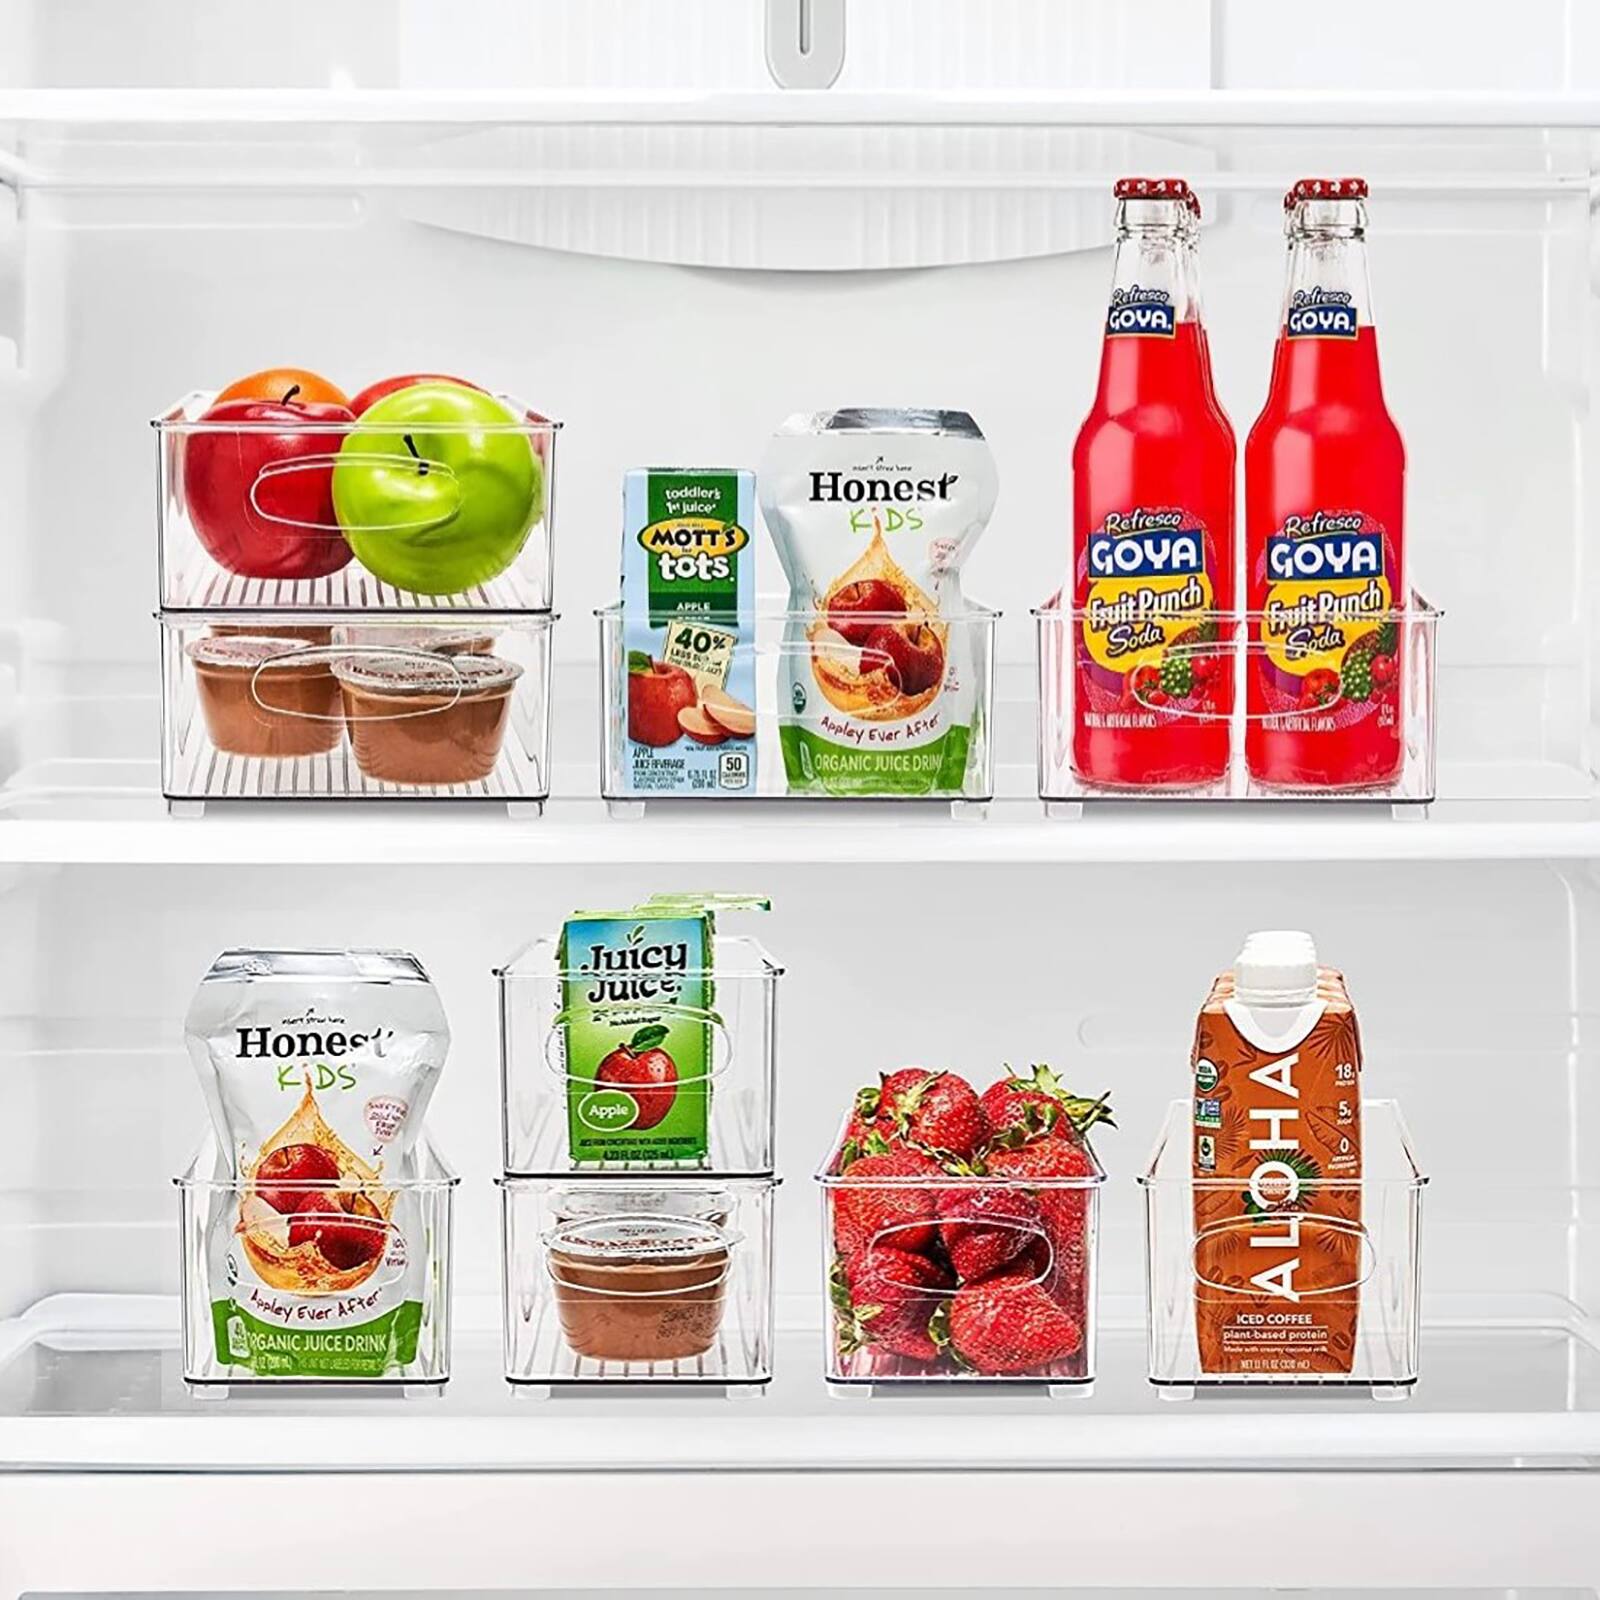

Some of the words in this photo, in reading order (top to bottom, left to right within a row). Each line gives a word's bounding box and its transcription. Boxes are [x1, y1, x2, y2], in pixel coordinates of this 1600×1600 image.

[1112, 285, 1169, 308] Refresco
[1294, 287, 1352, 310] Refresco
[808, 472, 959, 503] Honest
[1105, 508, 1182, 535] Refresco
[1285, 512, 1362, 538] Refresco
[1091, 537, 1197, 575] GOYA
[1270, 540, 1377, 578] GOYA
[676, 602, 711, 612] APPLE
[1091, 590, 1138, 630] Fruit
[1139, 577, 1202, 621] Punch
[1270, 594, 1317, 634] Fruit
[1319, 580, 1382, 622] Punch
[674, 627, 726, 654] 40%
[1108, 625, 1163, 656] Soda
[1288, 629, 1342, 658] Soda
[821, 715, 864, 744] Appley
[869, 729, 900, 742] Ever
[906, 712, 940, 738] After
[726, 757, 742, 771] 50
[814, 754, 872, 771] ORGANIC
[874, 754, 910, 771] JUICE
[912, 755, 943, 771] DRIN
[580, 942, 688, 977] Juicy
[235, 1027, 394, 1059] Honest
[589, 1103, 629, 1119] Apple
[1340, 1138, 1349, 1153] 0
[1249, 1052, 1300, 1303] ALOHA
[250, 1288, 293, 1323] Appley
[298, 1306, 331, 1321] Ever
[338, 1290, 378, 1317] After
[1236, 1314, 1265, 1325] ICED
[1266, 1314, 1313, 1325] COFFEE
[247, 1332, 301, 1351] RGANIC
[303, 1334, 342, 1351] JUICE
[344, 1334, 388, 1352] DRINK
[1223, 1329, 1287, 1340] plant-based
[1288, 1330, 1328, 1341] protein
